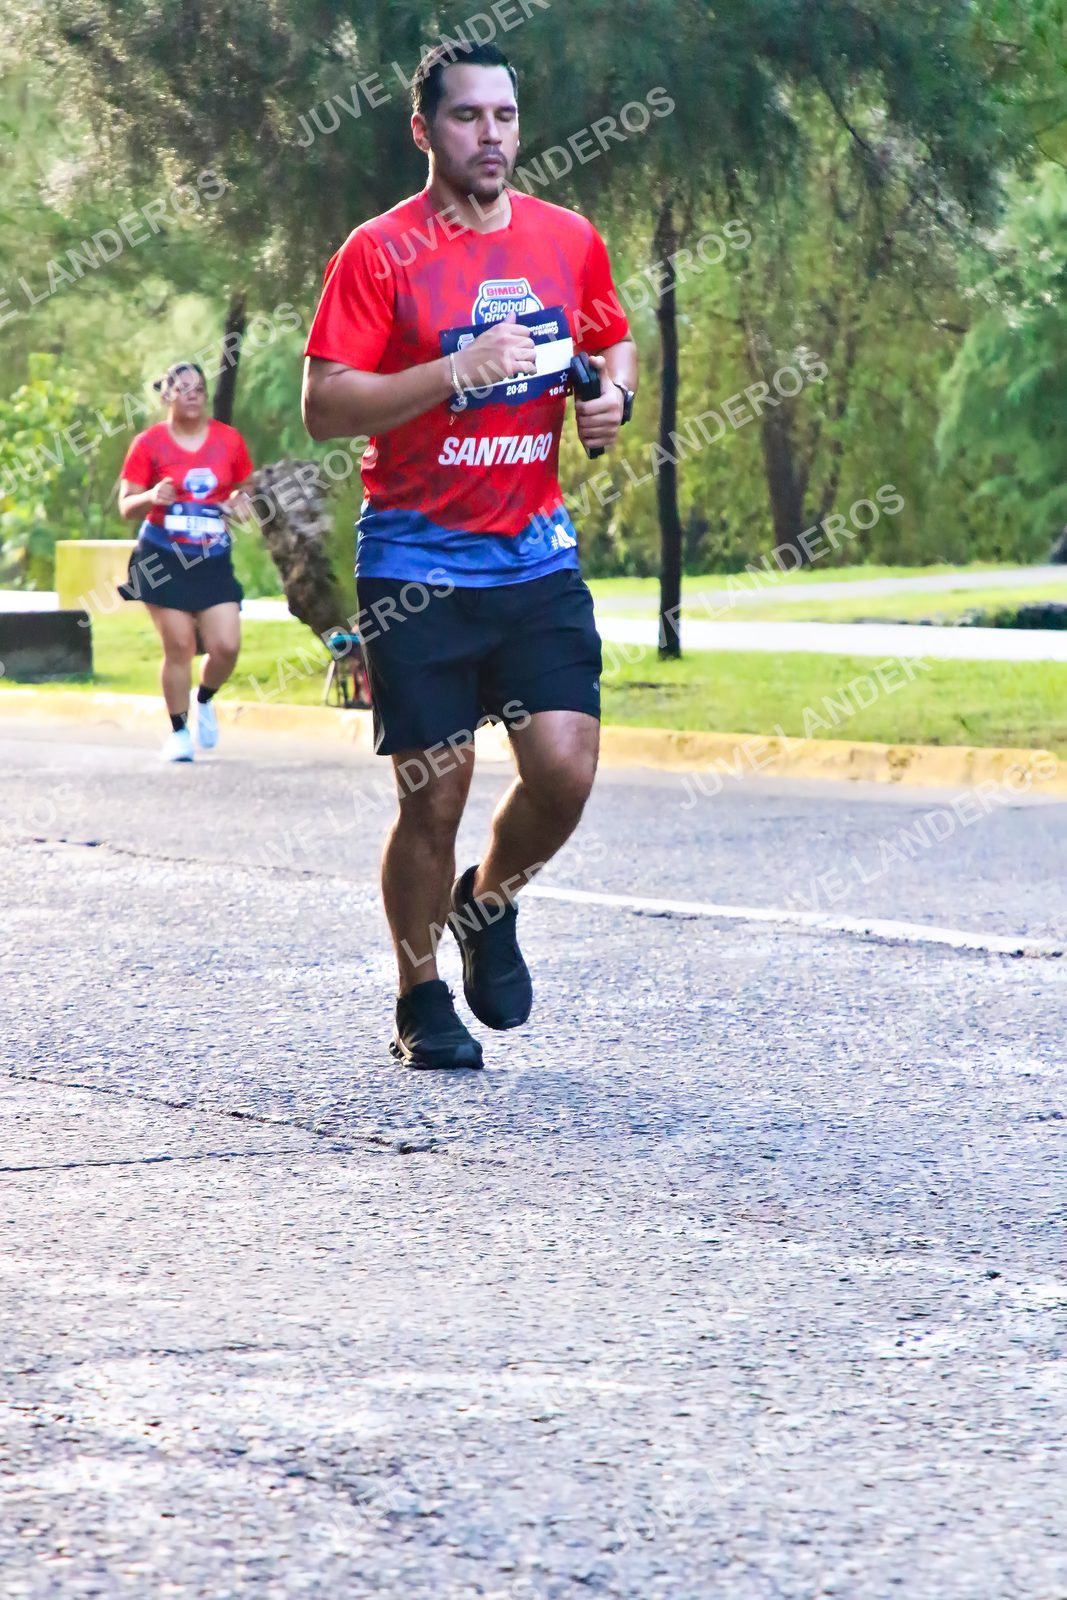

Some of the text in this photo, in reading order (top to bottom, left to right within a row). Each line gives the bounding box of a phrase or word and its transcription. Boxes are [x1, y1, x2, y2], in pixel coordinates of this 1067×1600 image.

[486, 285, 525, 297] BIMBO
[489, 299, 527, 314] Global
[438, 431, 553, 466] SANTIAGO
